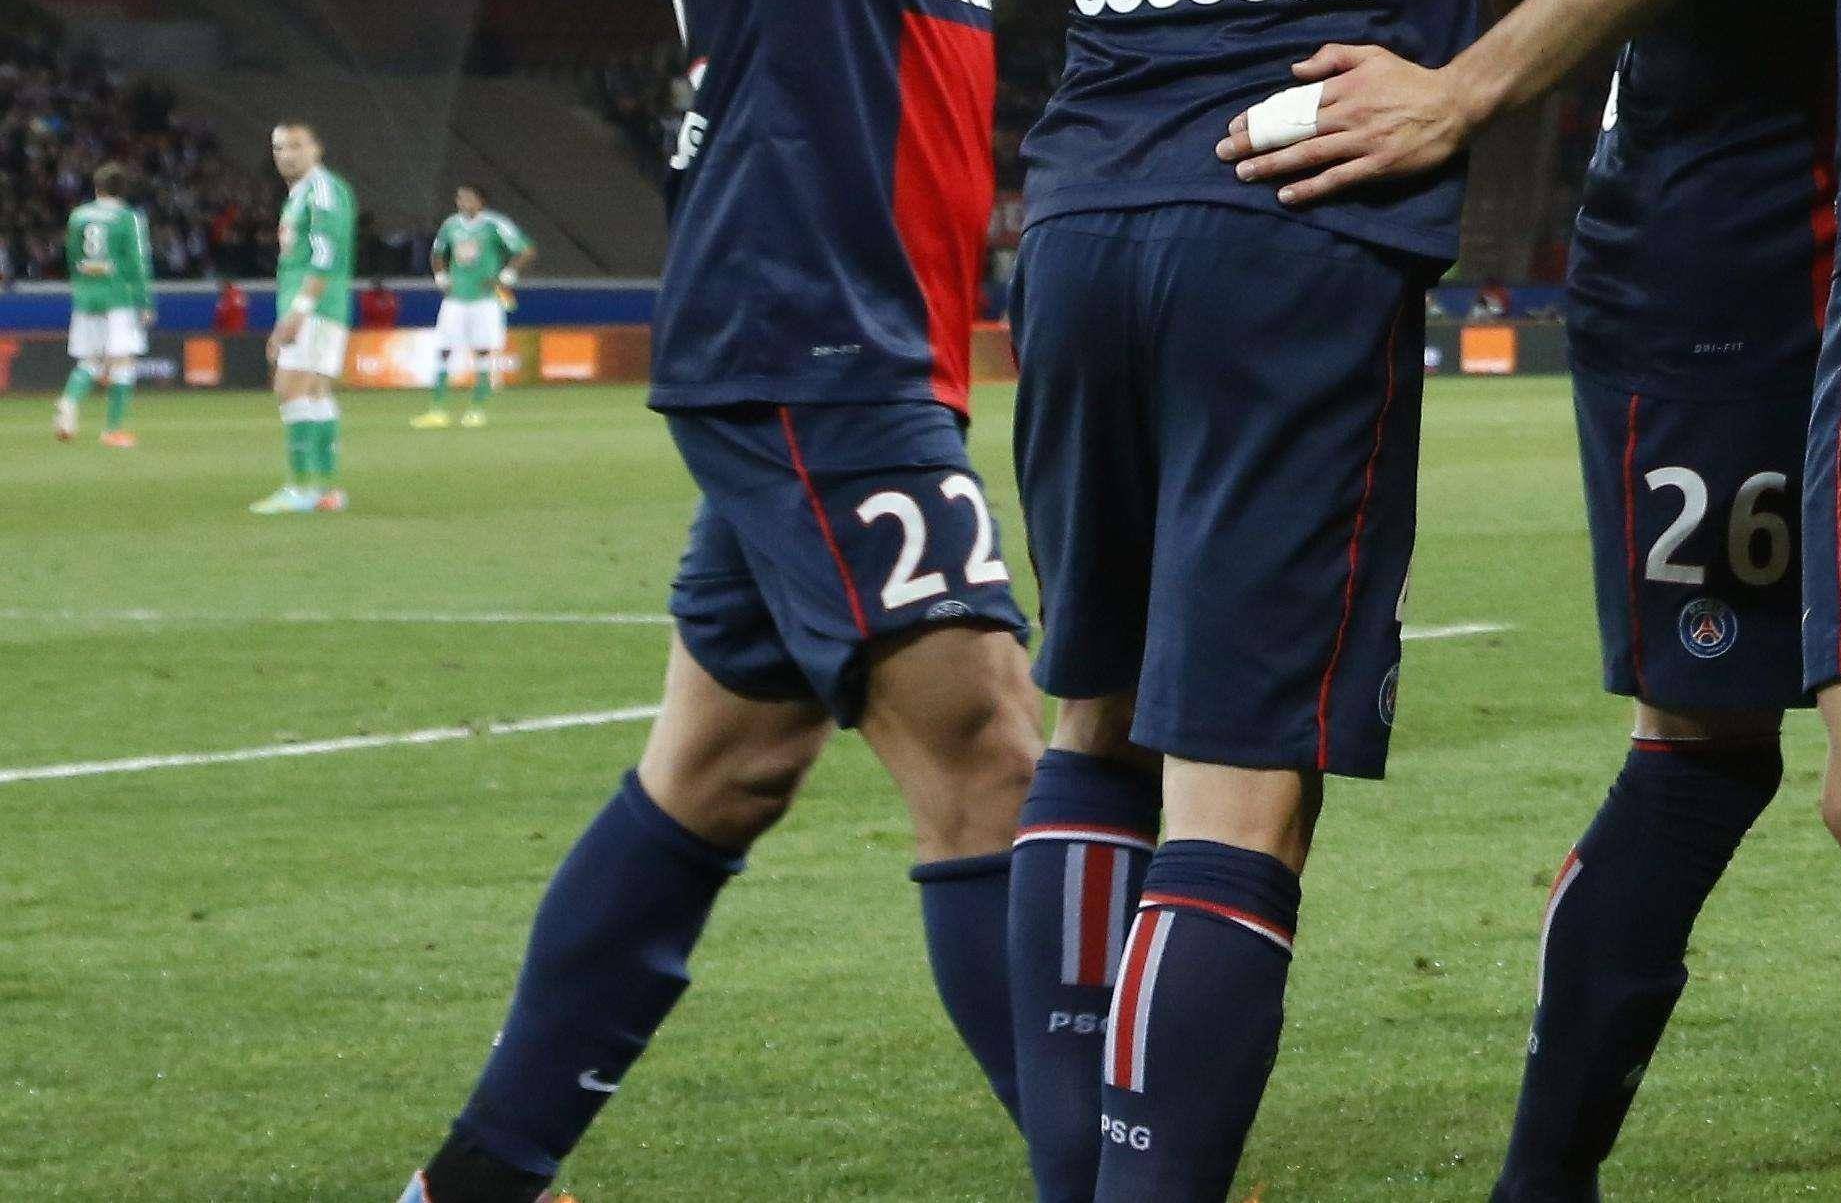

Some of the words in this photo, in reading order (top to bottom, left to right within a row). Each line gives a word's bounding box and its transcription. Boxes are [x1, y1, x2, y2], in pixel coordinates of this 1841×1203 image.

[855, 473, 1011, 611] 22
[1644, 465, 1791, 585] 26
[1047, 1010, 1108, 1035] PS
